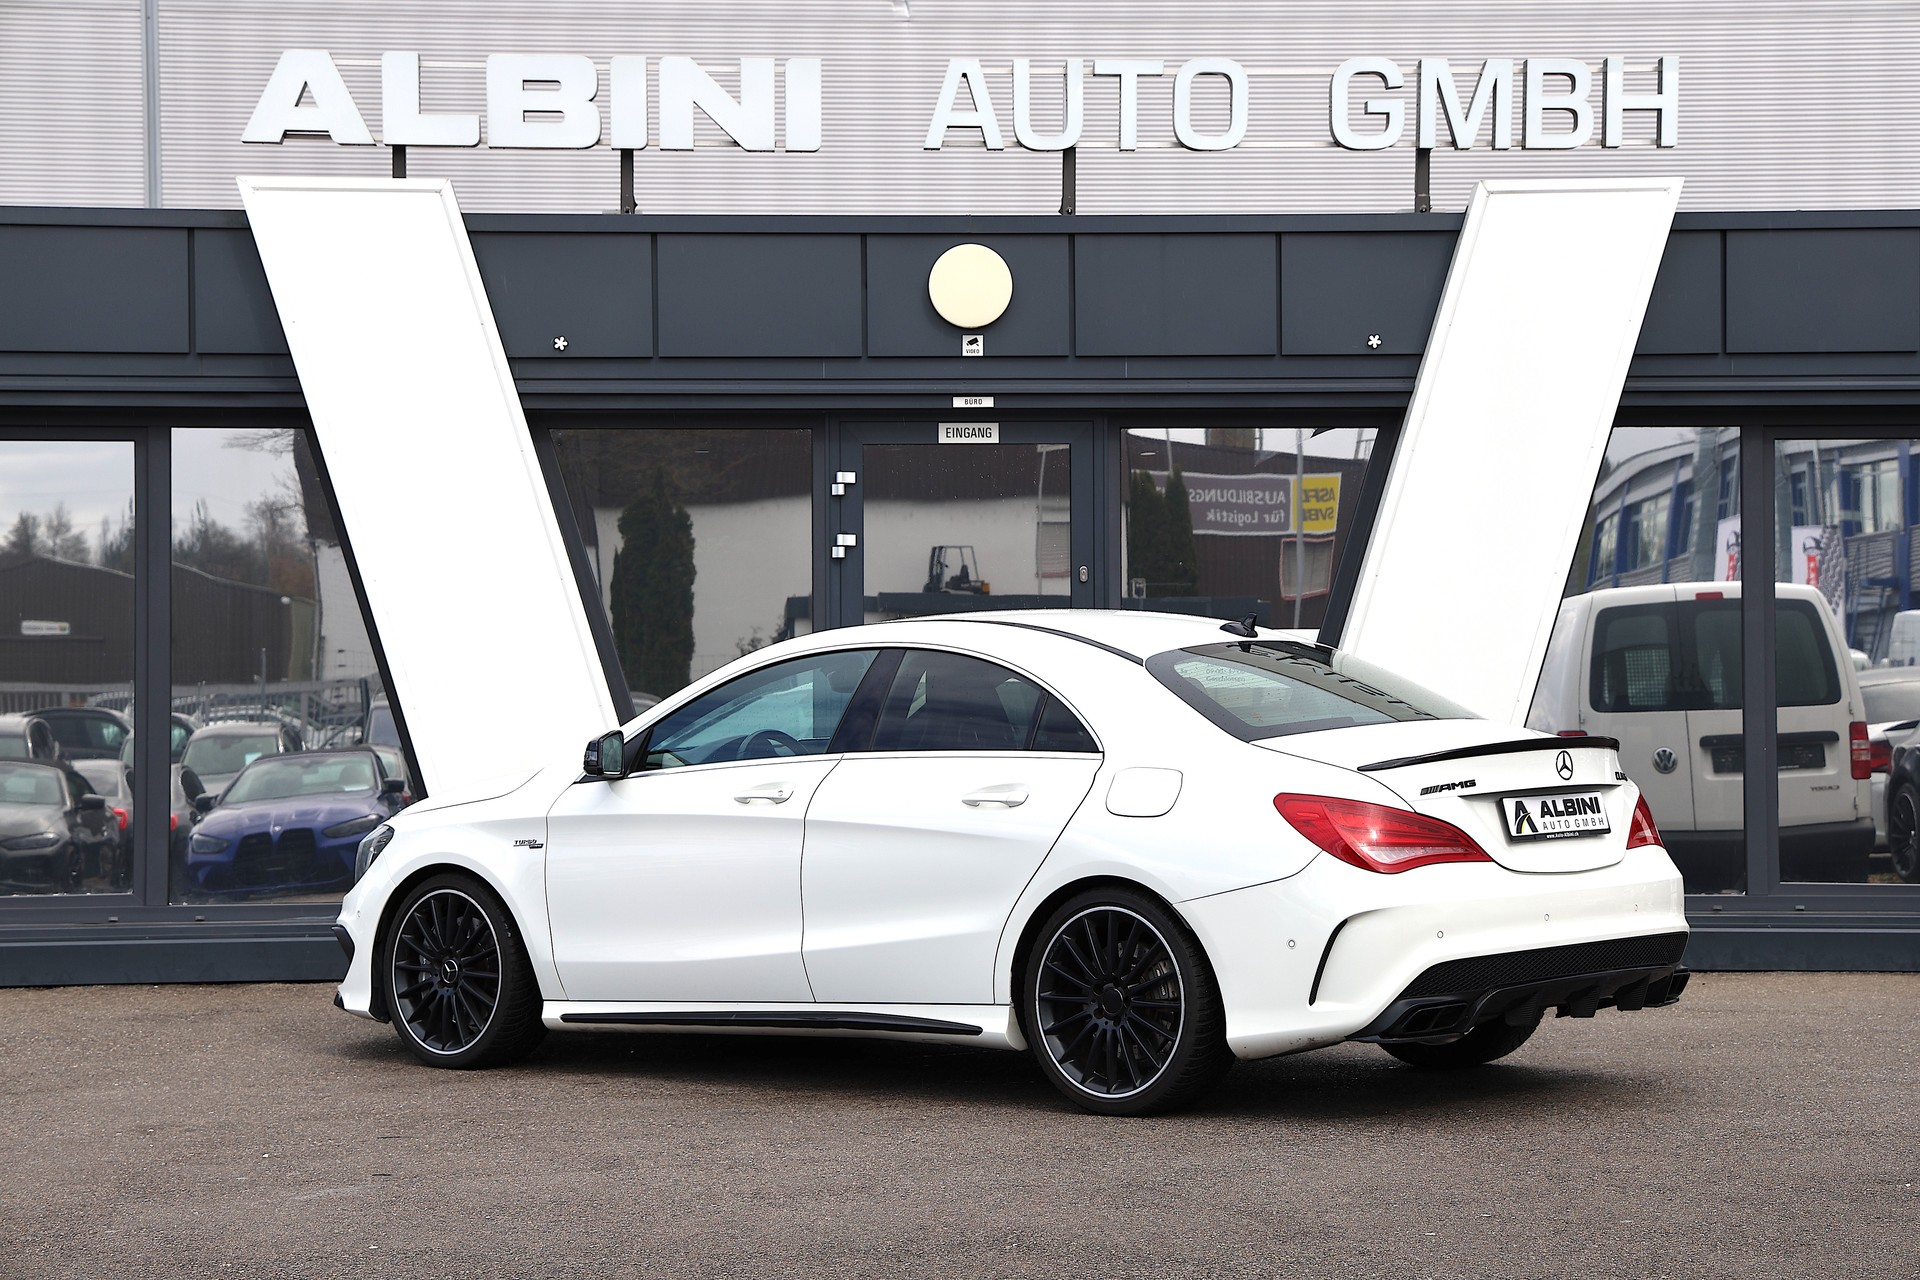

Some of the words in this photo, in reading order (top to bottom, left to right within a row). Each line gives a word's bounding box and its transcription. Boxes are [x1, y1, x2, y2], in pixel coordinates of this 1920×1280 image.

[241, 49, 822, 152] ALBINI
[923, 57, 1249, 151] AUTO
[1329, 56, 1680, 150] GMBH
[945, 427, 992, 438] EINGANG
[1437, 779, 1477, 793] AMG
[1540, 796, 1601, 818] ALBINI
[1542, 819, 1570, 831] AUTO
[1575, 816, 1605, 828] GMBH
